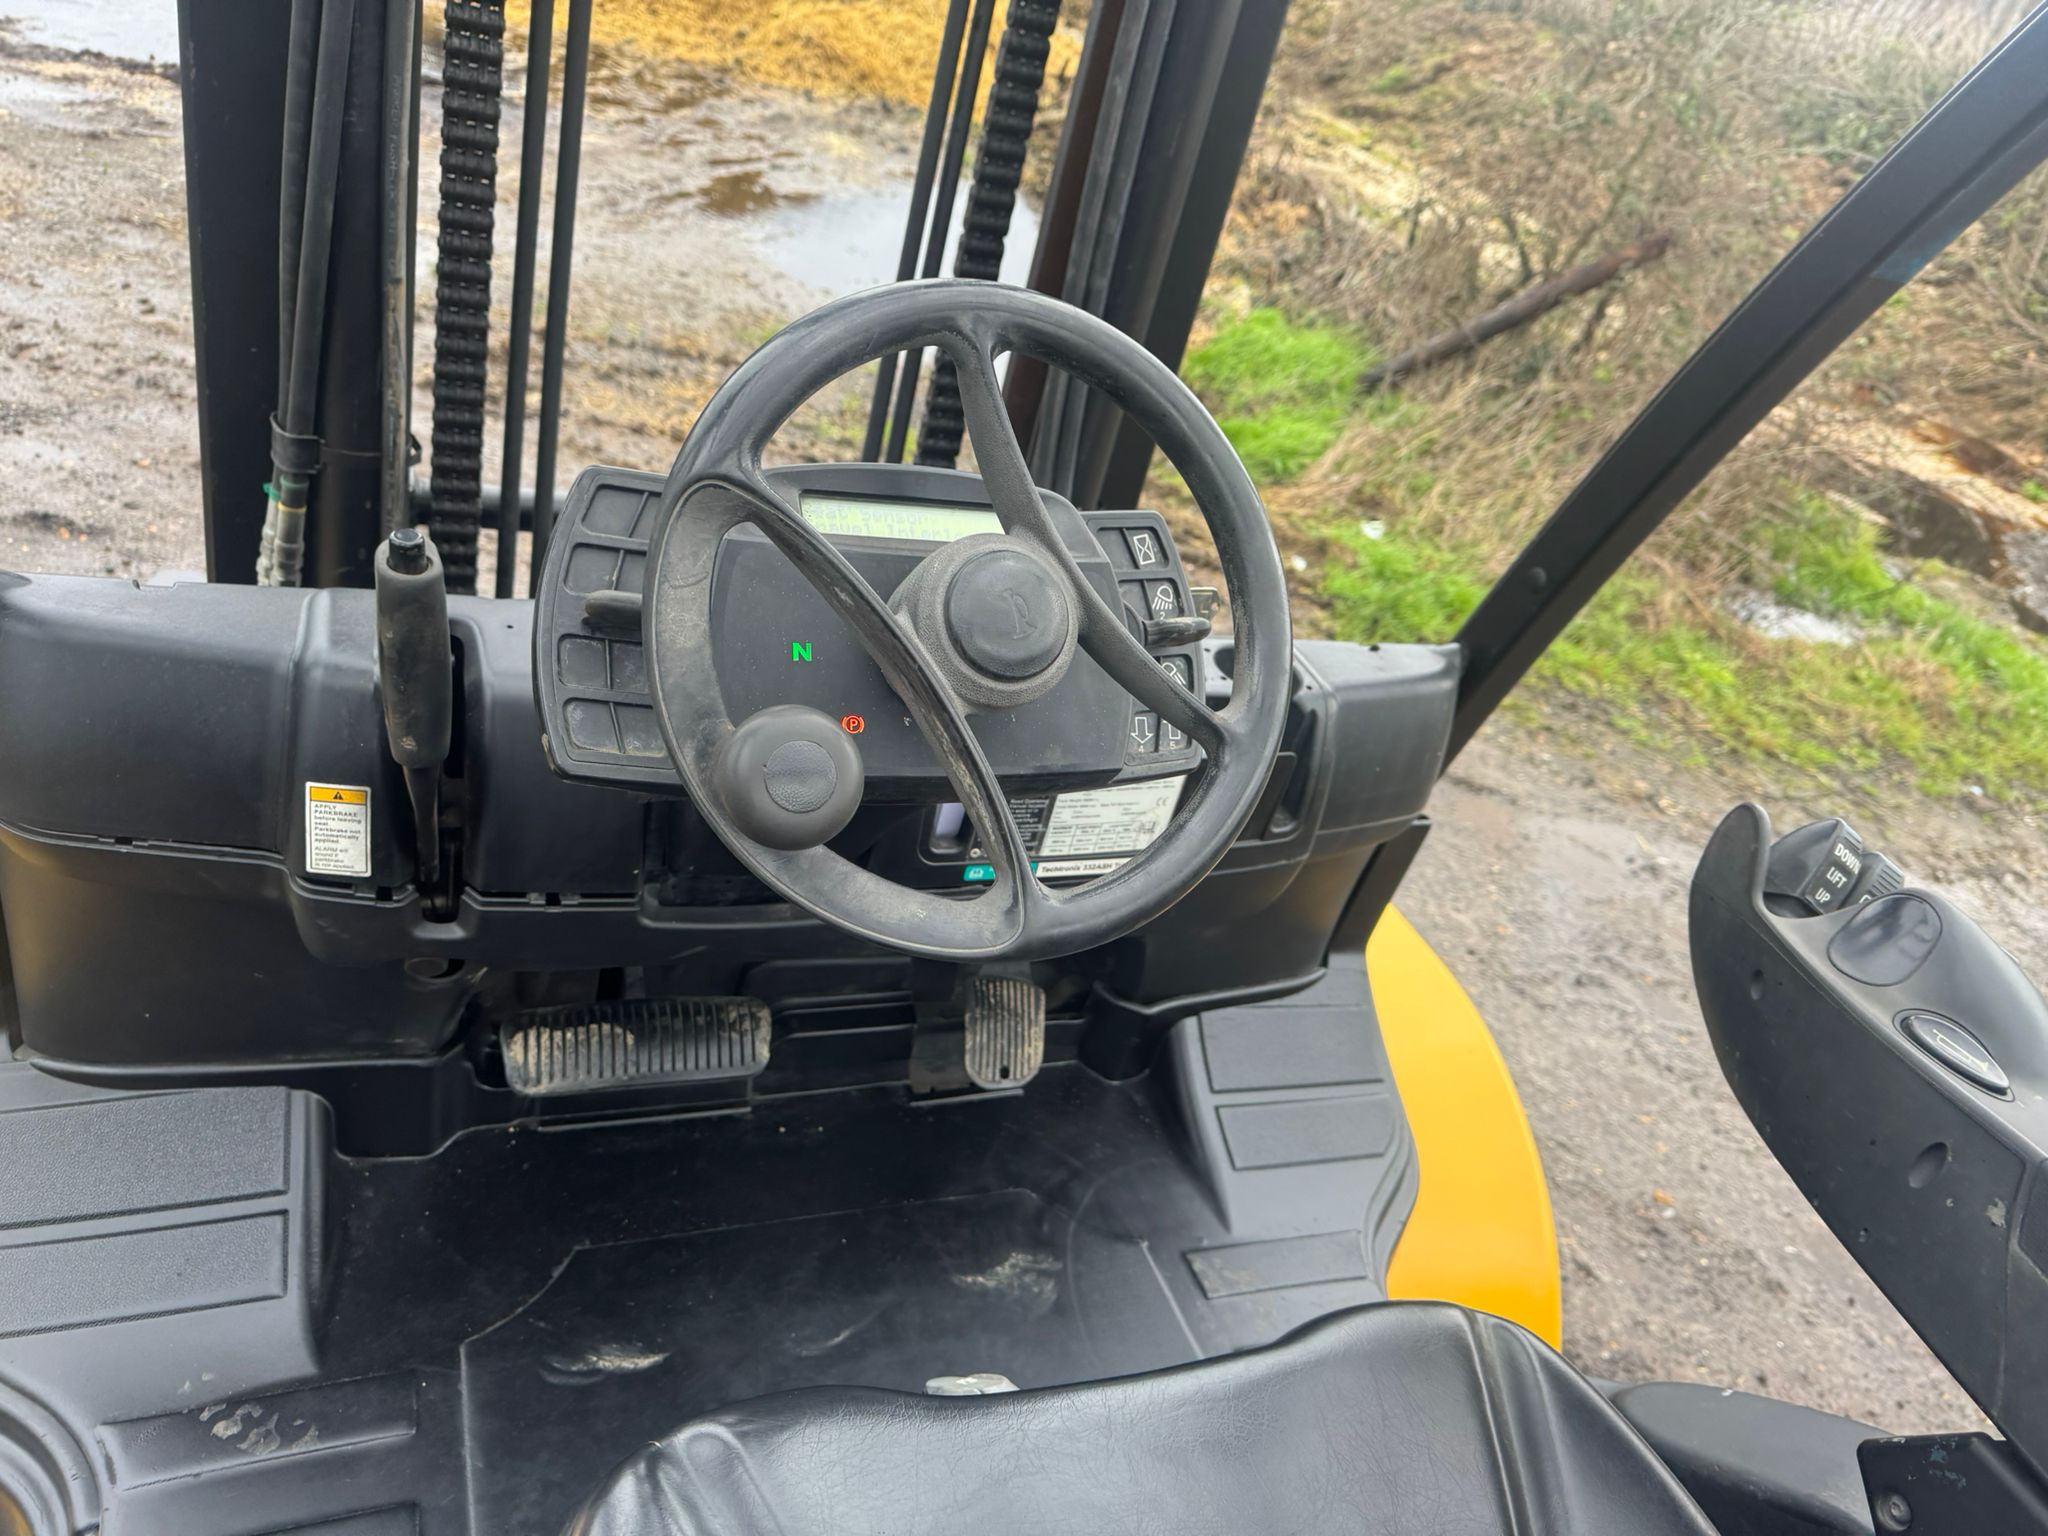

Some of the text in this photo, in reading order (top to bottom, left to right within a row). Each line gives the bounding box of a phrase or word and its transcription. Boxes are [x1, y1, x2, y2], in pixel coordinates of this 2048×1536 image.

[792, 642, 812, 662] N
[1834, 843, 1862, 875] DOWN
[1826, 867, 1848, 888] LIFT
[1815, 888, 1831, 904] UP
